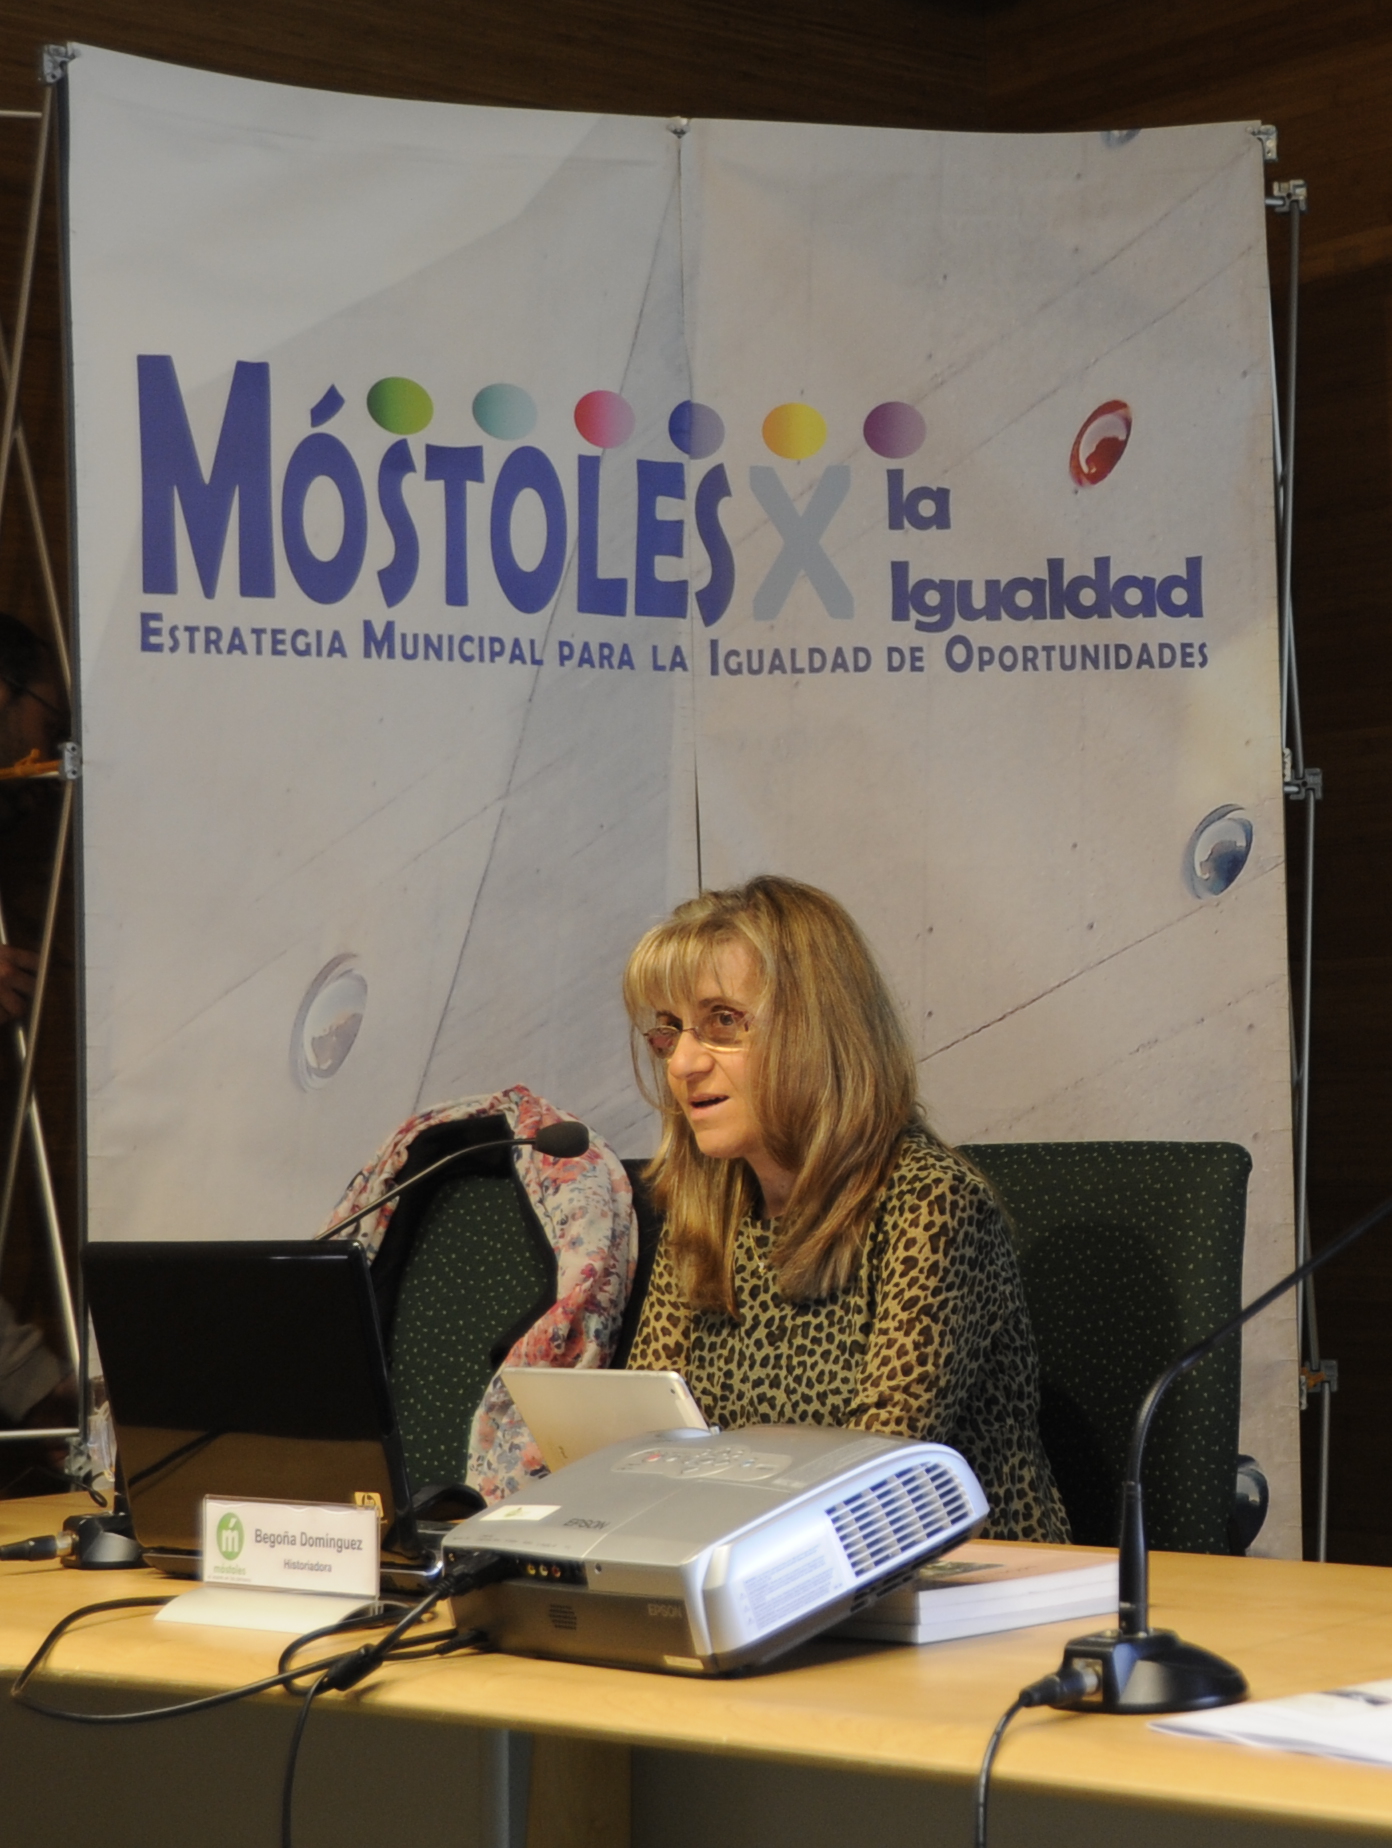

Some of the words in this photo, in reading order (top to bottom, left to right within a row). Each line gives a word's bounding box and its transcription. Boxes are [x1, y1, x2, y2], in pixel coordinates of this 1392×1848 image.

[137, 354, 736, 629] MÓSTOLES
[748, 464, 855, 621] X
[886, 468, 951, 530] la
[890, 555, 1204, 633] Igualdad
[140, 612, 348, 659] ESTRATEGIA
[363, 620, 544, 667] MUNICIPAL
[558, 641, 635, 671] PARA
[652, 644, 689, 673] LA
[709, 638, 872, 677] IGUALDAD
[887, 646, 925, 673] DE
[945, 635, 1209, 674] OPORTUNIDADES
[254, 1528, 297, 1549] Begoña
[299, 1531, 364, 1554] Domínguez
[563, 1517, 609, 1531] EPSON
[283, 1558, 333, 1574] Historiadora
